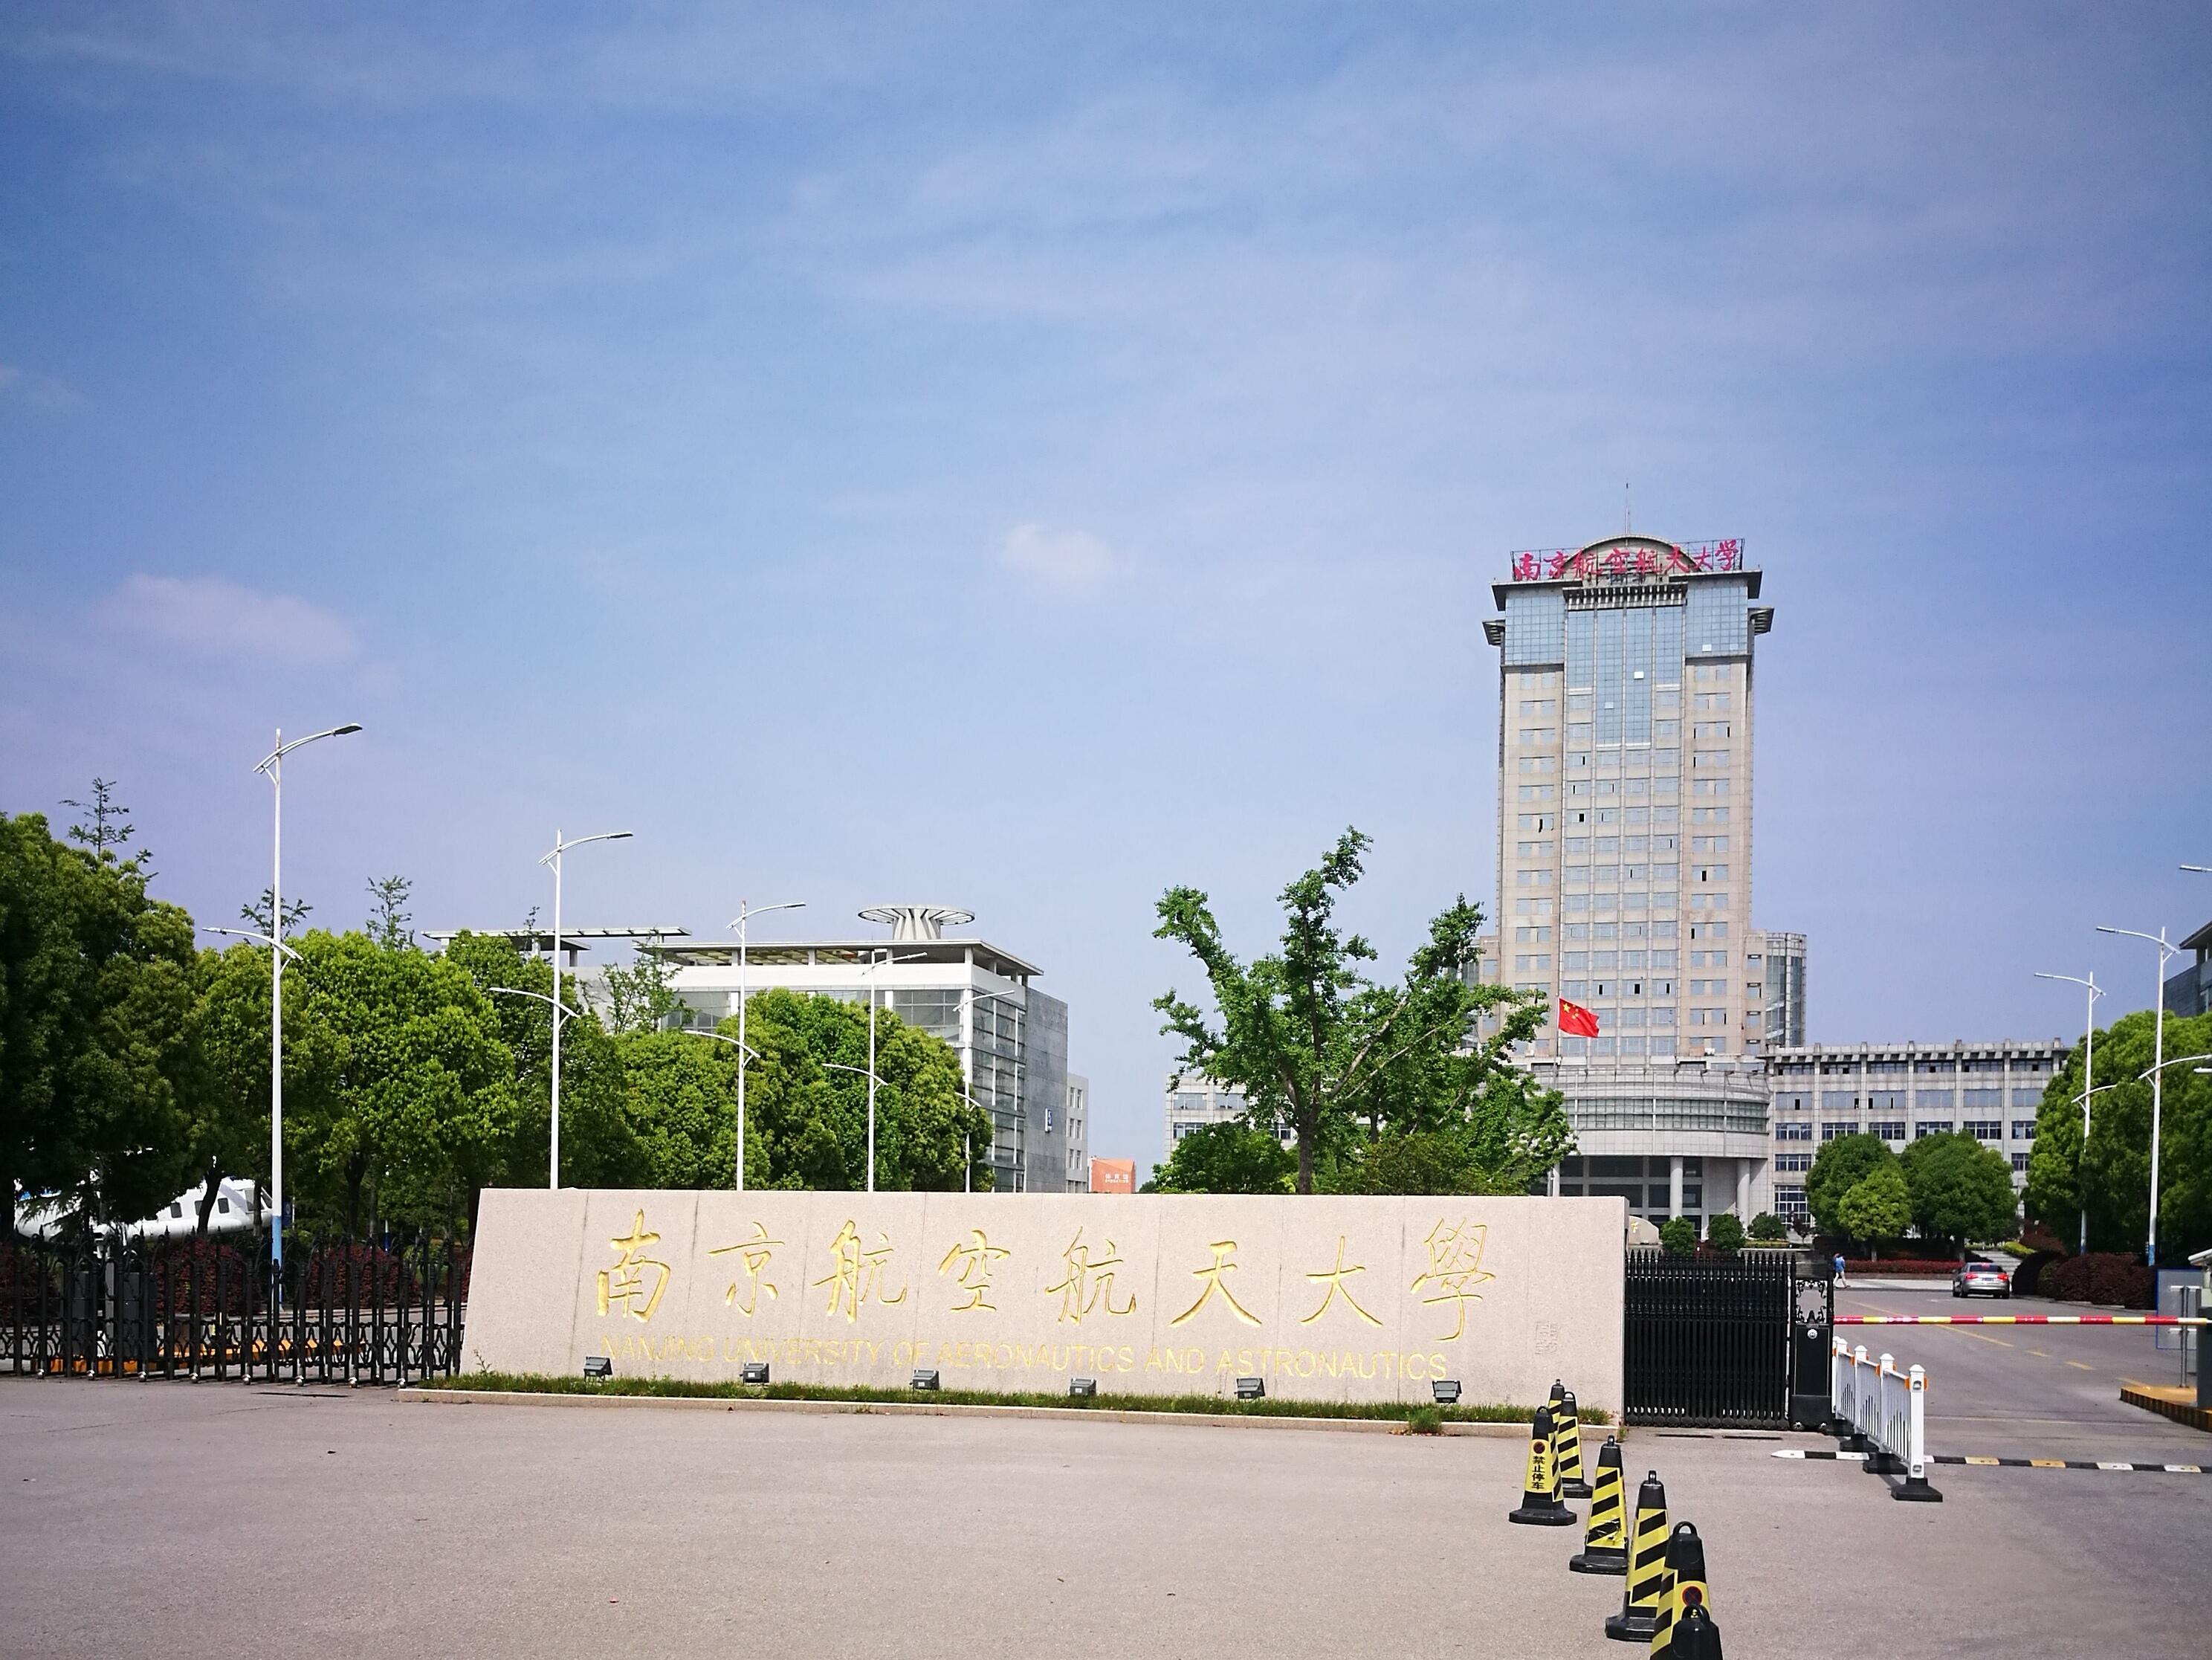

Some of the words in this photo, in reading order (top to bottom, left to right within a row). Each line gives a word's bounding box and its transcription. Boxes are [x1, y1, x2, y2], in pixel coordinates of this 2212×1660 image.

[1513, 539, 1738, 581] 南京航空航天大学
[597, 1208, 1496, 1342] 南京航空航天大學
[601, 1336, 714, 1361] NANJING
[723, 1337, 882, 1365] UNIVERSITY
[893, 1340, 931, 1368] OF
[935, 1341, 1134, 1372] AERONAUTICS
[1145, 1346, 1204, 1375] AND
[1215, 1347, 1447, 1380] ASTRONAUTICS
[1531, 1456, 1545, 1489] 禁止停车
